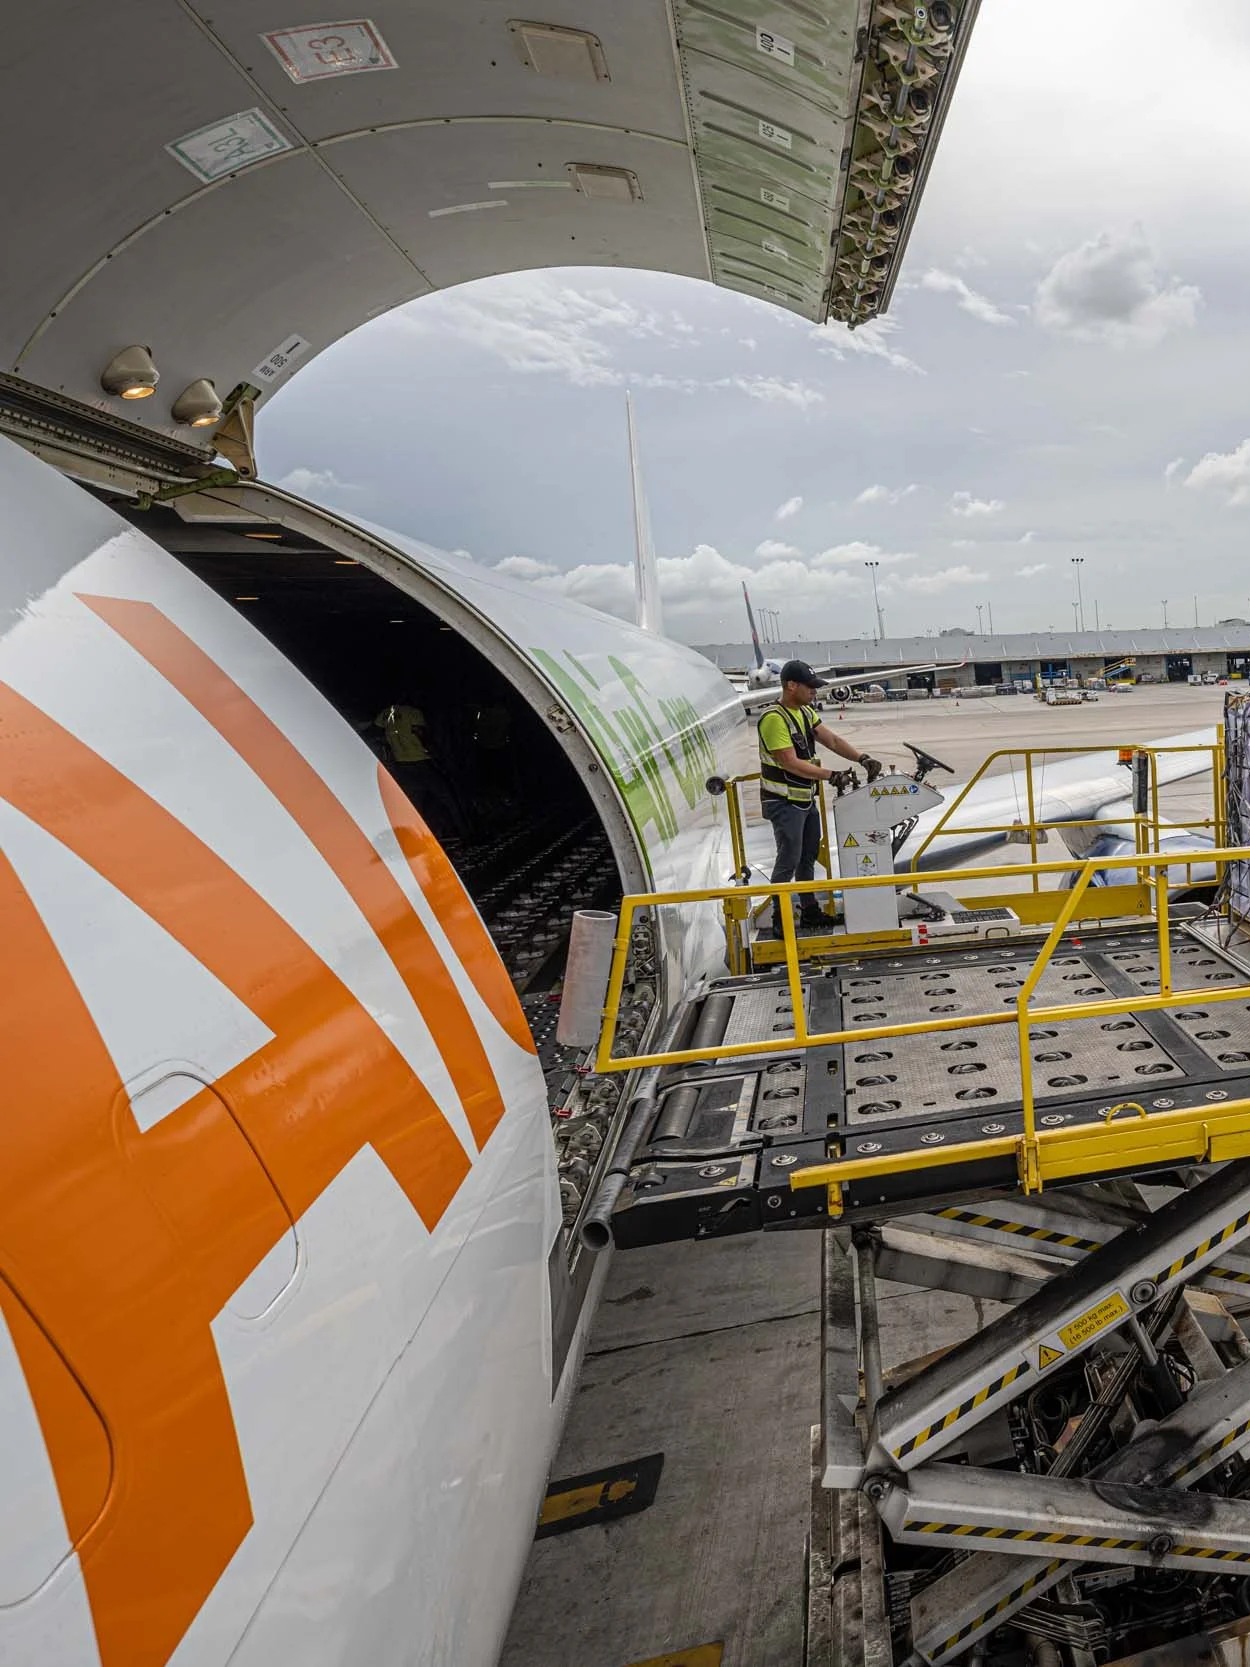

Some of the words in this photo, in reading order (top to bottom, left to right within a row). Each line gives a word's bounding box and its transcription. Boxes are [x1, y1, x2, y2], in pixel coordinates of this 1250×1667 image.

[309, 35, 356, 66] E3
[208, 127, 261, 162] A3L
[1074, 1319, 1087, 1329] 500
[1082, 1324, 1095, 1335] 500
